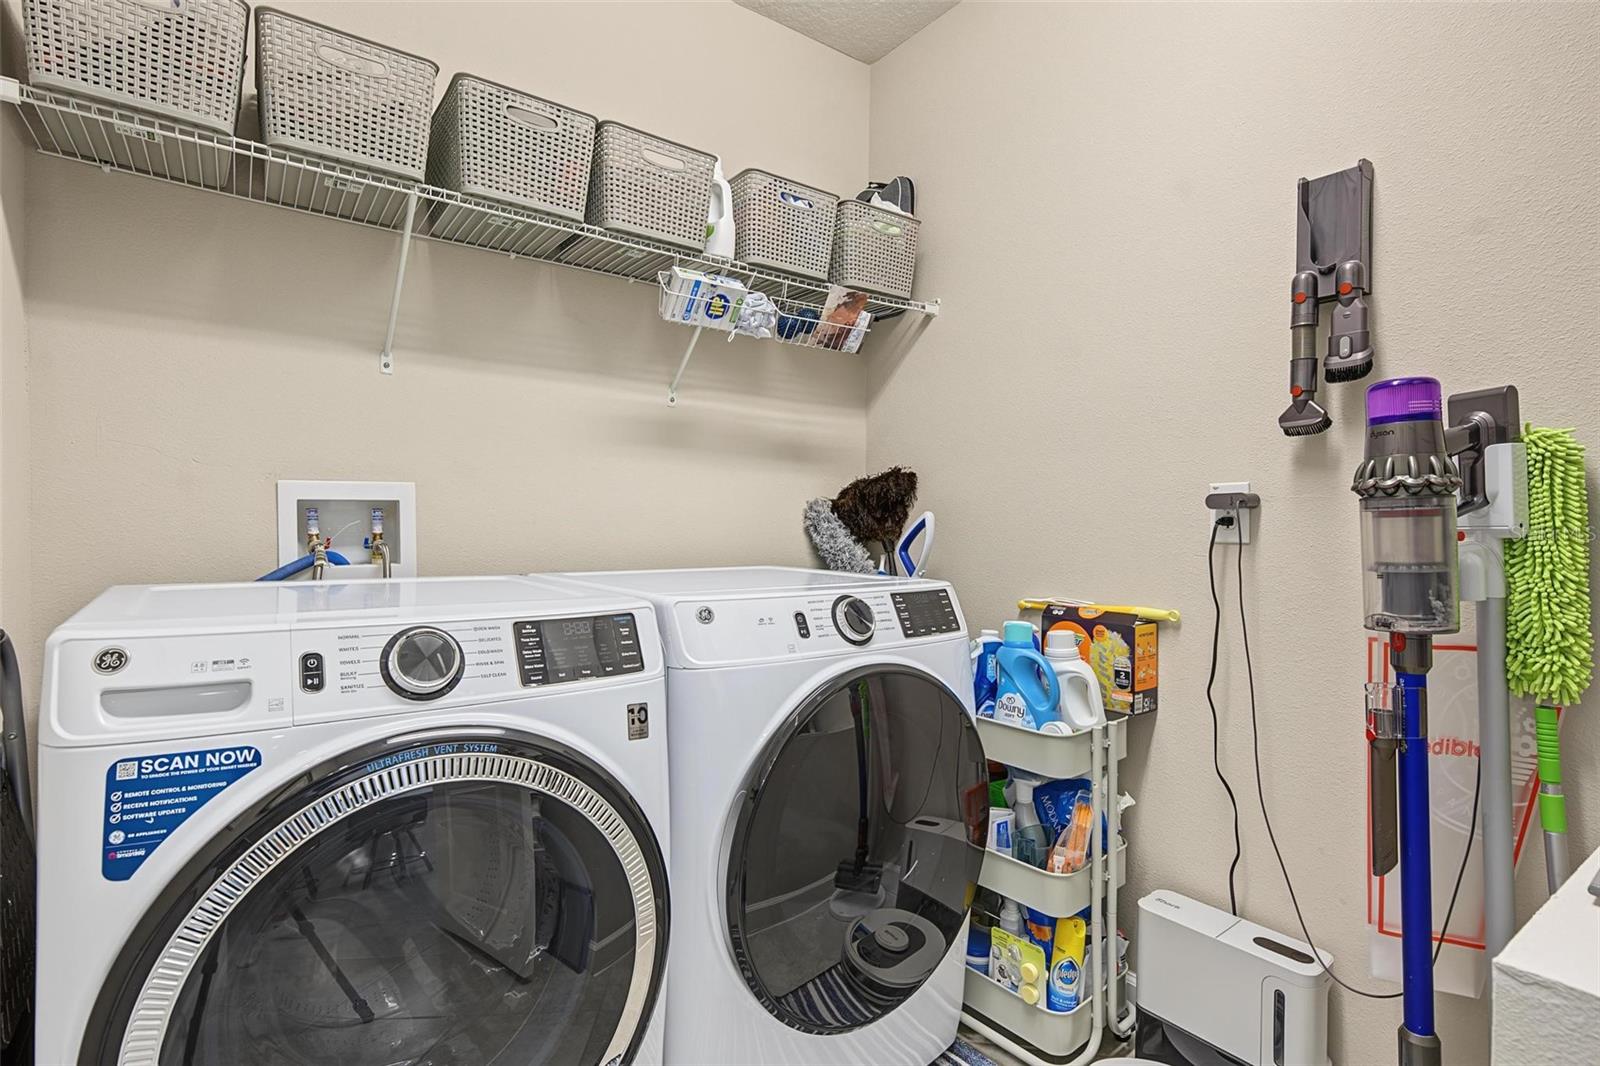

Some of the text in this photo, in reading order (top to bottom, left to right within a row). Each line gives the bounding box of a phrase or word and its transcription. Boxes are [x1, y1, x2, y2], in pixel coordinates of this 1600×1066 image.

[1119, 671, 1126, 679] 2
[998, 700, 1025, 719] Downy
[141, 749, 256, 773] SCAN NOW
[367, 744, 497, 772] ULTRAFRESH VENT SYSTEM
[124, 790, 149, 799] REMOTE
[151, 787, 181, 795] CONTROL
[188, 781, 227, 791] MONITORING
[123, 796, 198, 810] RECEIVE NOTIFICATIONS
[122, 808, 186, 821] SOFTWARE UPDATES
